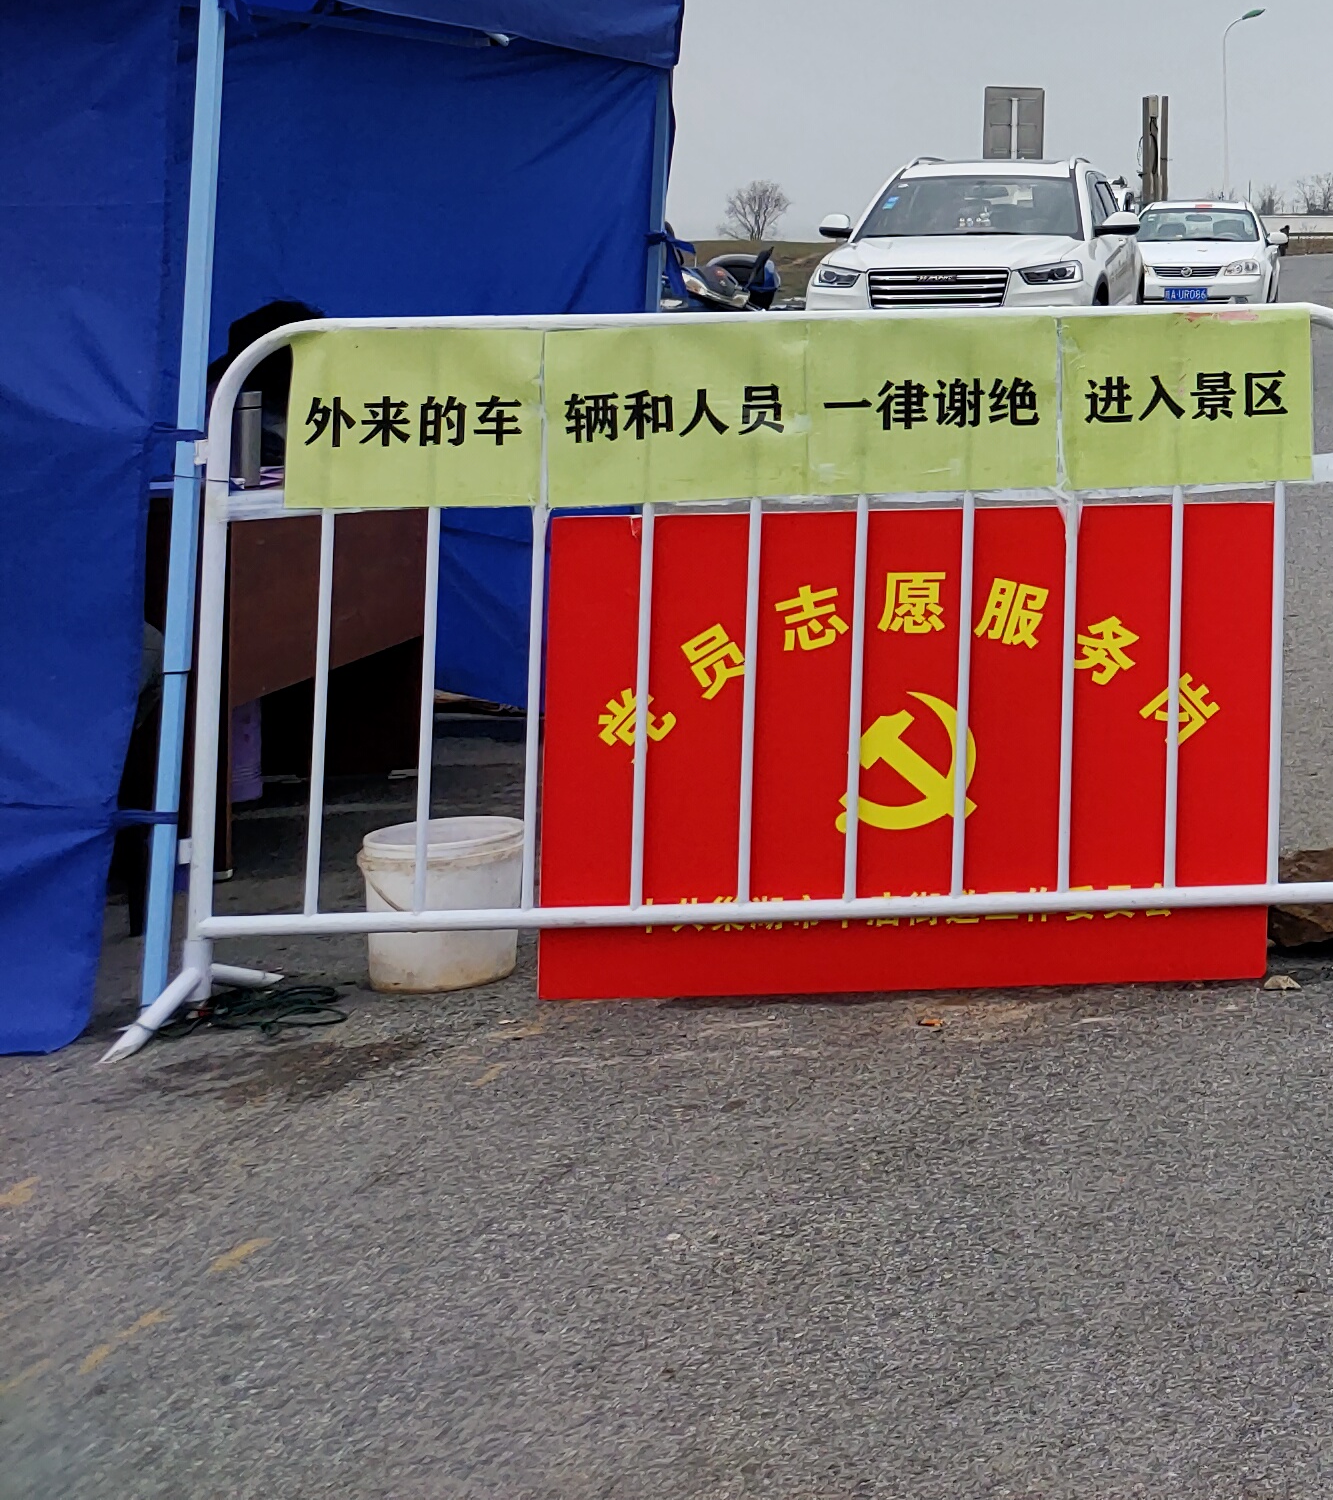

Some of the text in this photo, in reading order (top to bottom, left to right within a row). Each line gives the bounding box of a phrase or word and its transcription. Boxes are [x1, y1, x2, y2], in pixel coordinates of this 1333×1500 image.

[597, 572, 1220, 763] 党员志愿服务岗
